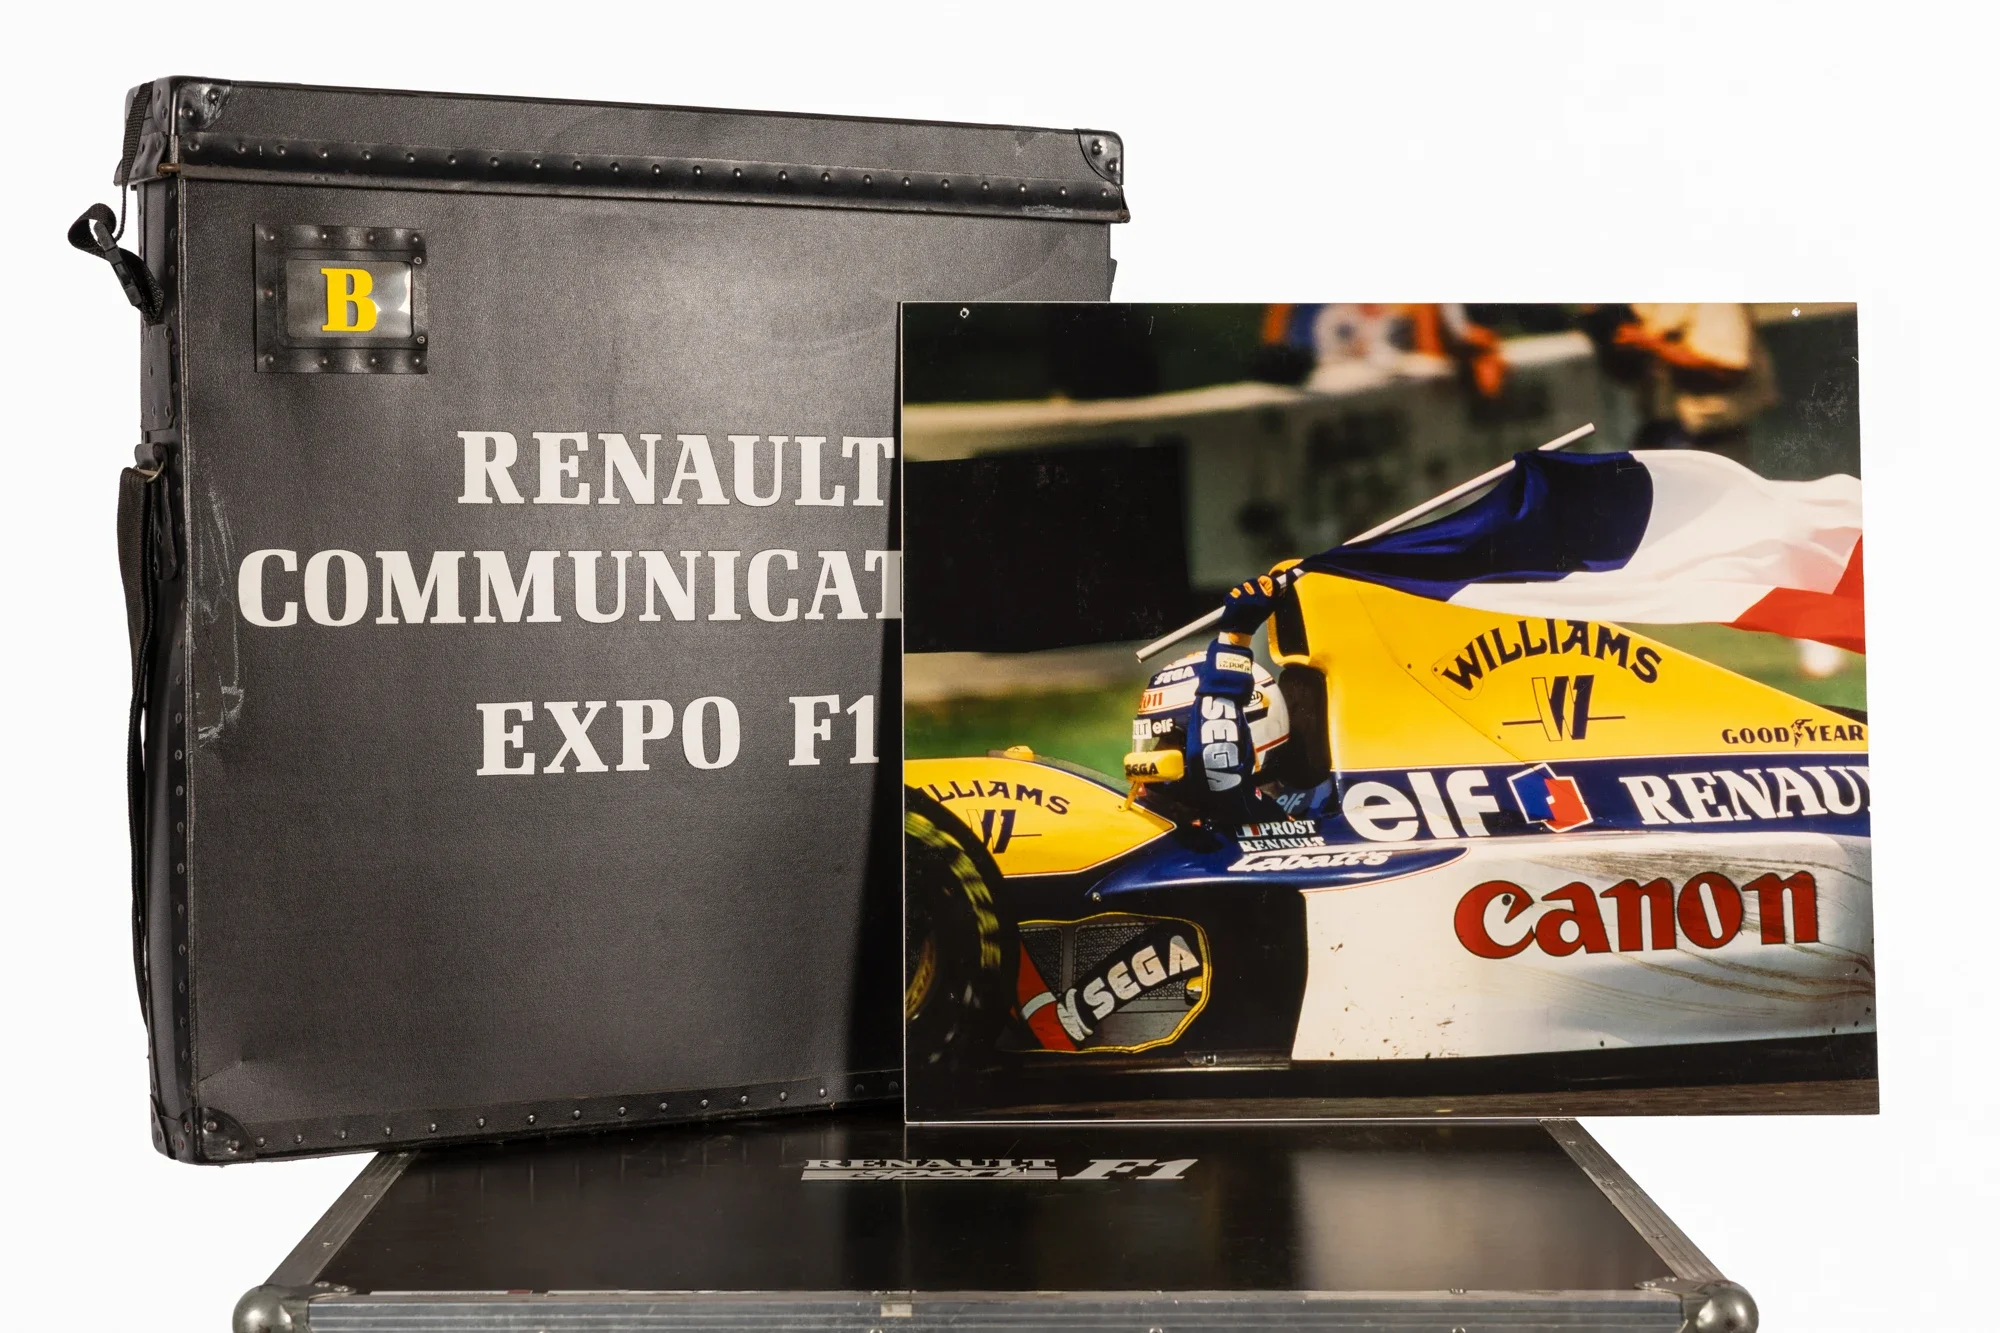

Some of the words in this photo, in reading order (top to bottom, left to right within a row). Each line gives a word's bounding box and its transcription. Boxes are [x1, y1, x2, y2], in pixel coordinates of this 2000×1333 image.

[321, 268, 377, 332] B
[457, 430, 895, 507] RENAULT
[1441, 617, 1662, 692] WILLIAMS
[475, 697, 741, 776] EXPO
[788, 695, 879, 767] F1
[1201, 695, 1242, 792] SEGA
[1721, 727, 1790, 745] GOOD
[1804, 724, 1865, 742] YEAR
[1124, 762, 1159, 776] SEGA
[916, 780, 1071, 815] LLIAMS
[1342, 769, 1500, 842] elf
[1238, 836, 1326, 852] RENAULT
[1260, 820, 1316, 836] PROST
[1453, 871, 1820, 960] Canon
[1083, 935, 1200, 1020] SEGA
[805, 1159, 1057, 1169] RENAULT
[850, 1164, 1025, 1180] sport
[1061, 1159, 1198, 1180] F1
